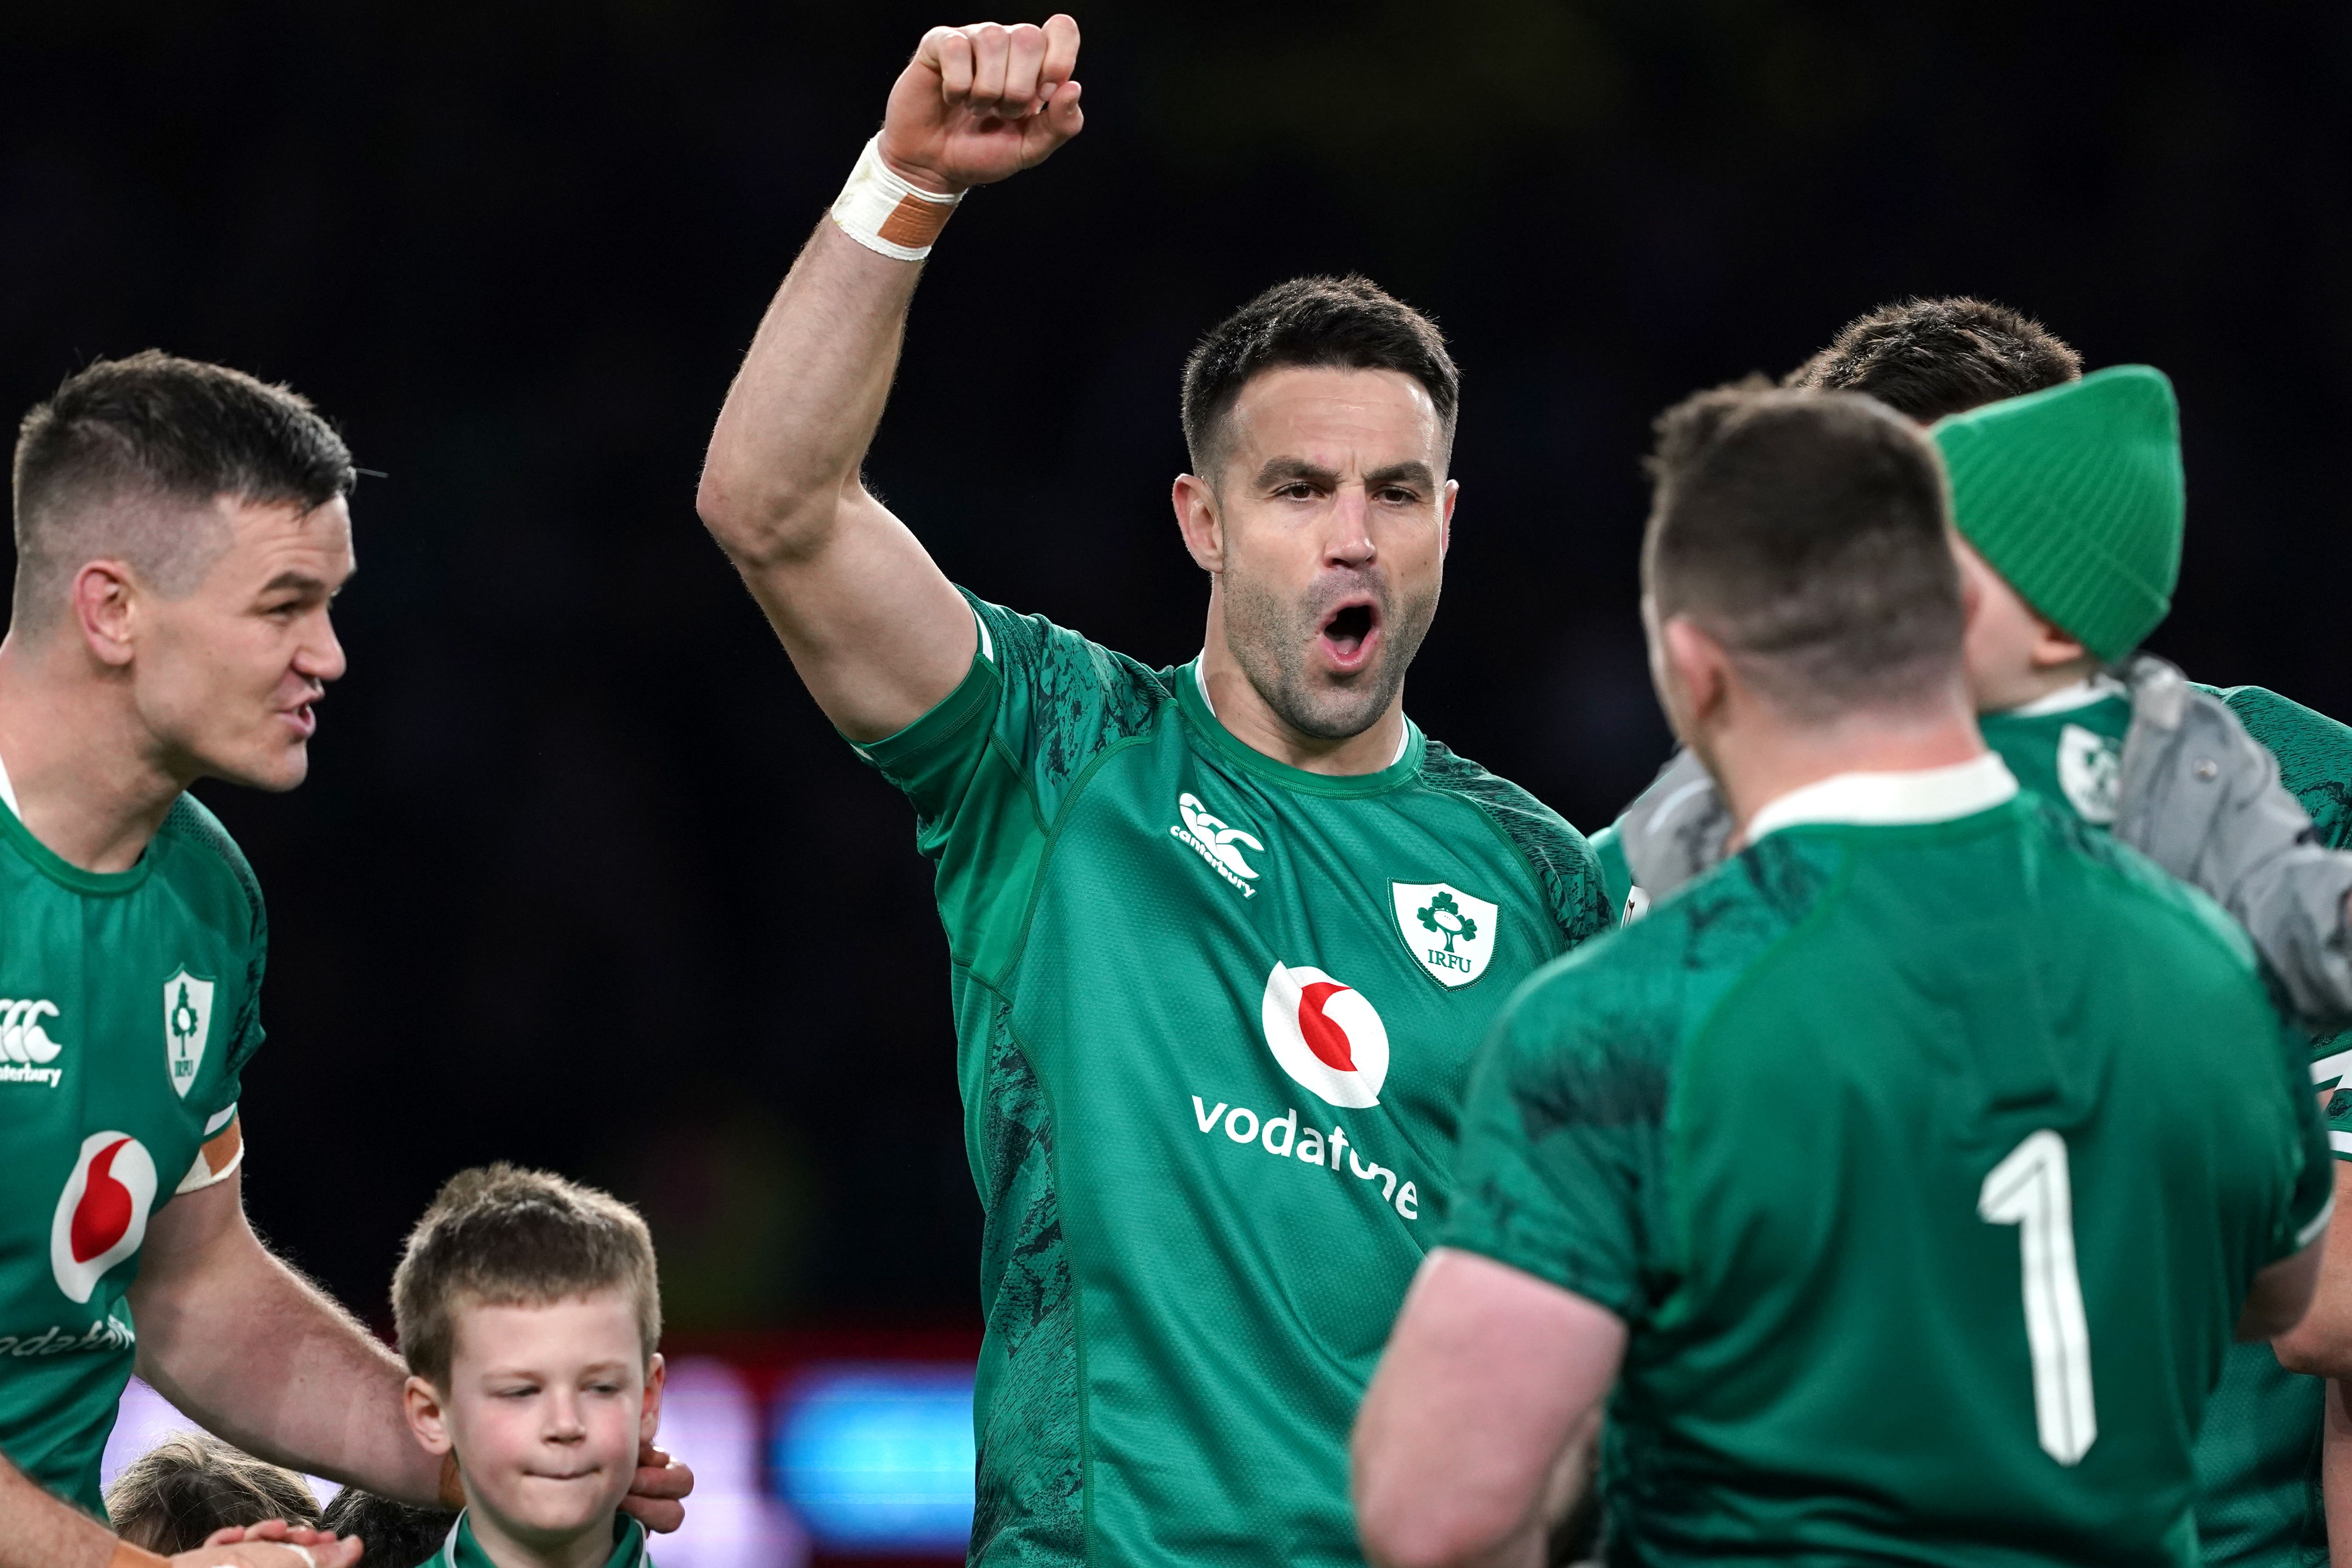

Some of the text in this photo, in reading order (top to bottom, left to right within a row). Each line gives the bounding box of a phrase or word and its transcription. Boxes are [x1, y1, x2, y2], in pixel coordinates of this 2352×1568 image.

[1170, 826, 1256, 898] canterbury
[1427, 949, 1472, 973] IRFU
[1976, 1128, 2098, 1467] 1
